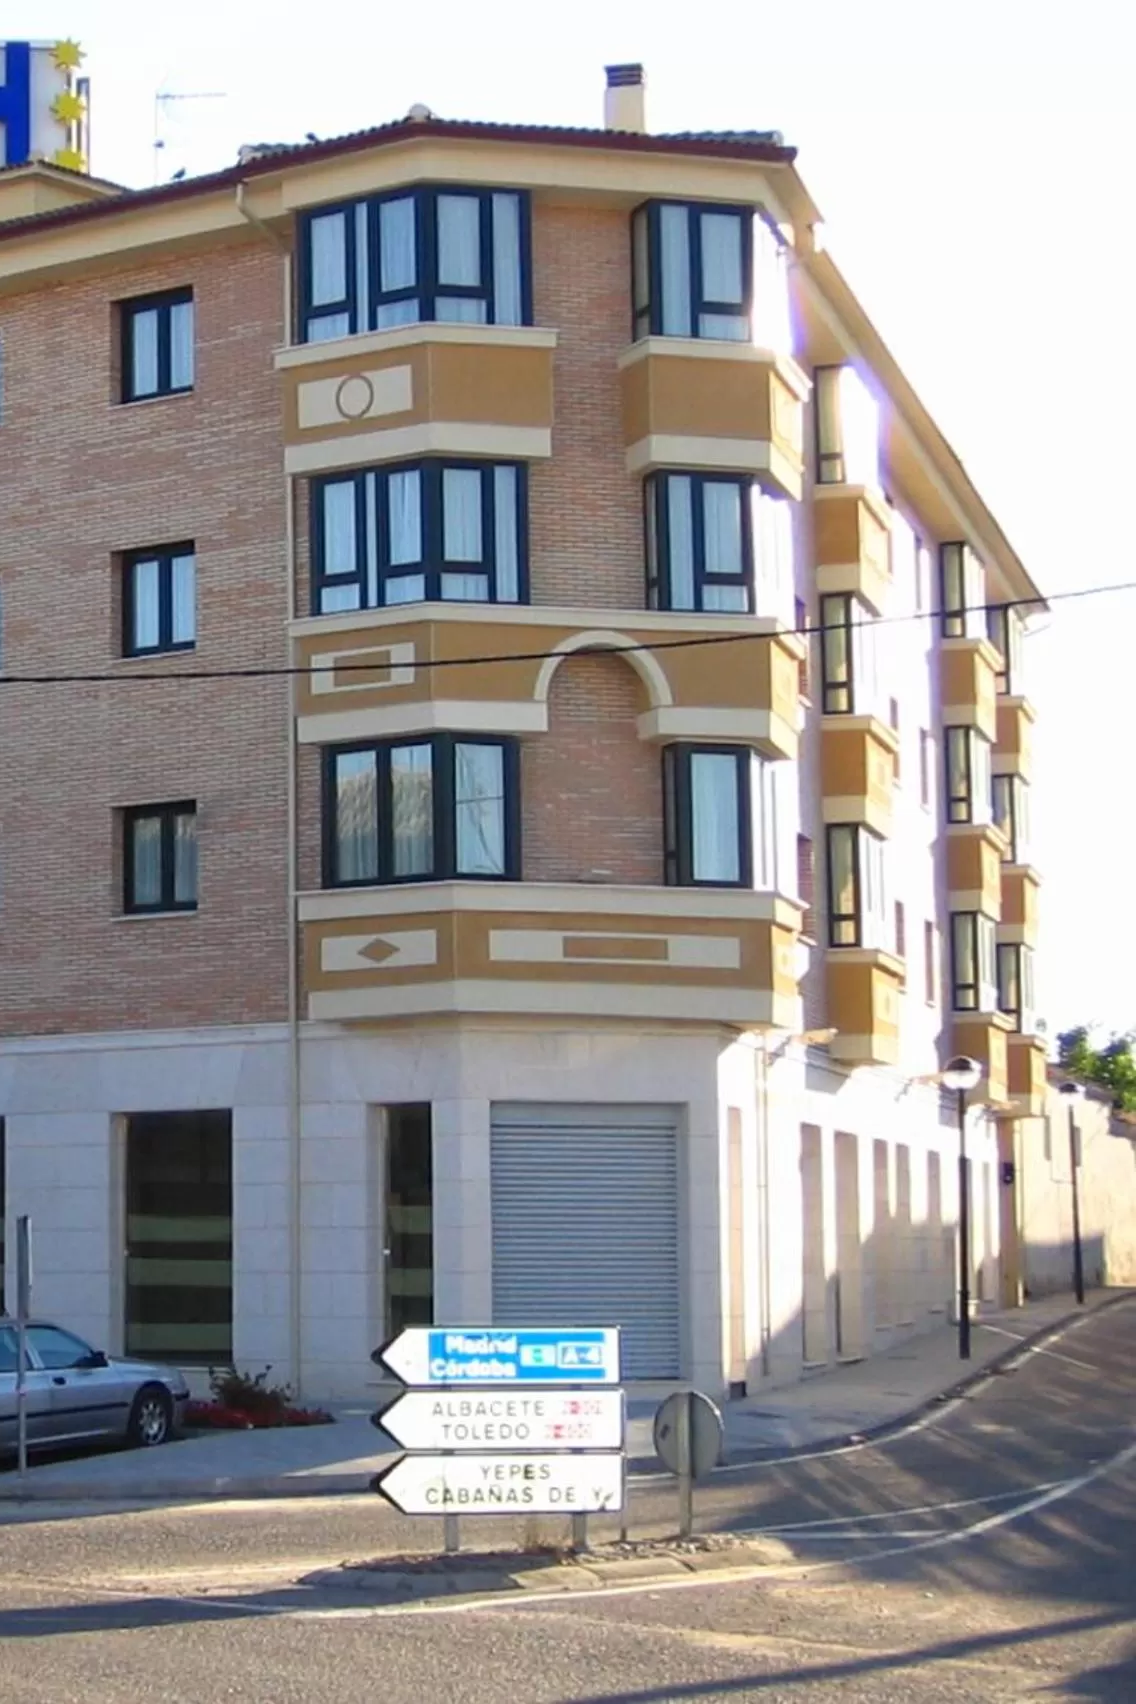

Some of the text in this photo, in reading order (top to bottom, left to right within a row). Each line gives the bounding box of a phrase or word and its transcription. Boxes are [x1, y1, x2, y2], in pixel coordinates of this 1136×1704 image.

[445, 1333, 517, 1354] Madrid
[432, 1400, 545, 1417] ALBACETE
[441, 1423, 530, 1440] TOLEDO
[480, 1463, 551, 1480] YEPES
[425, 1484, 533, 1504] CABAÑAS
[549, 1487, 577, 1503] DE
